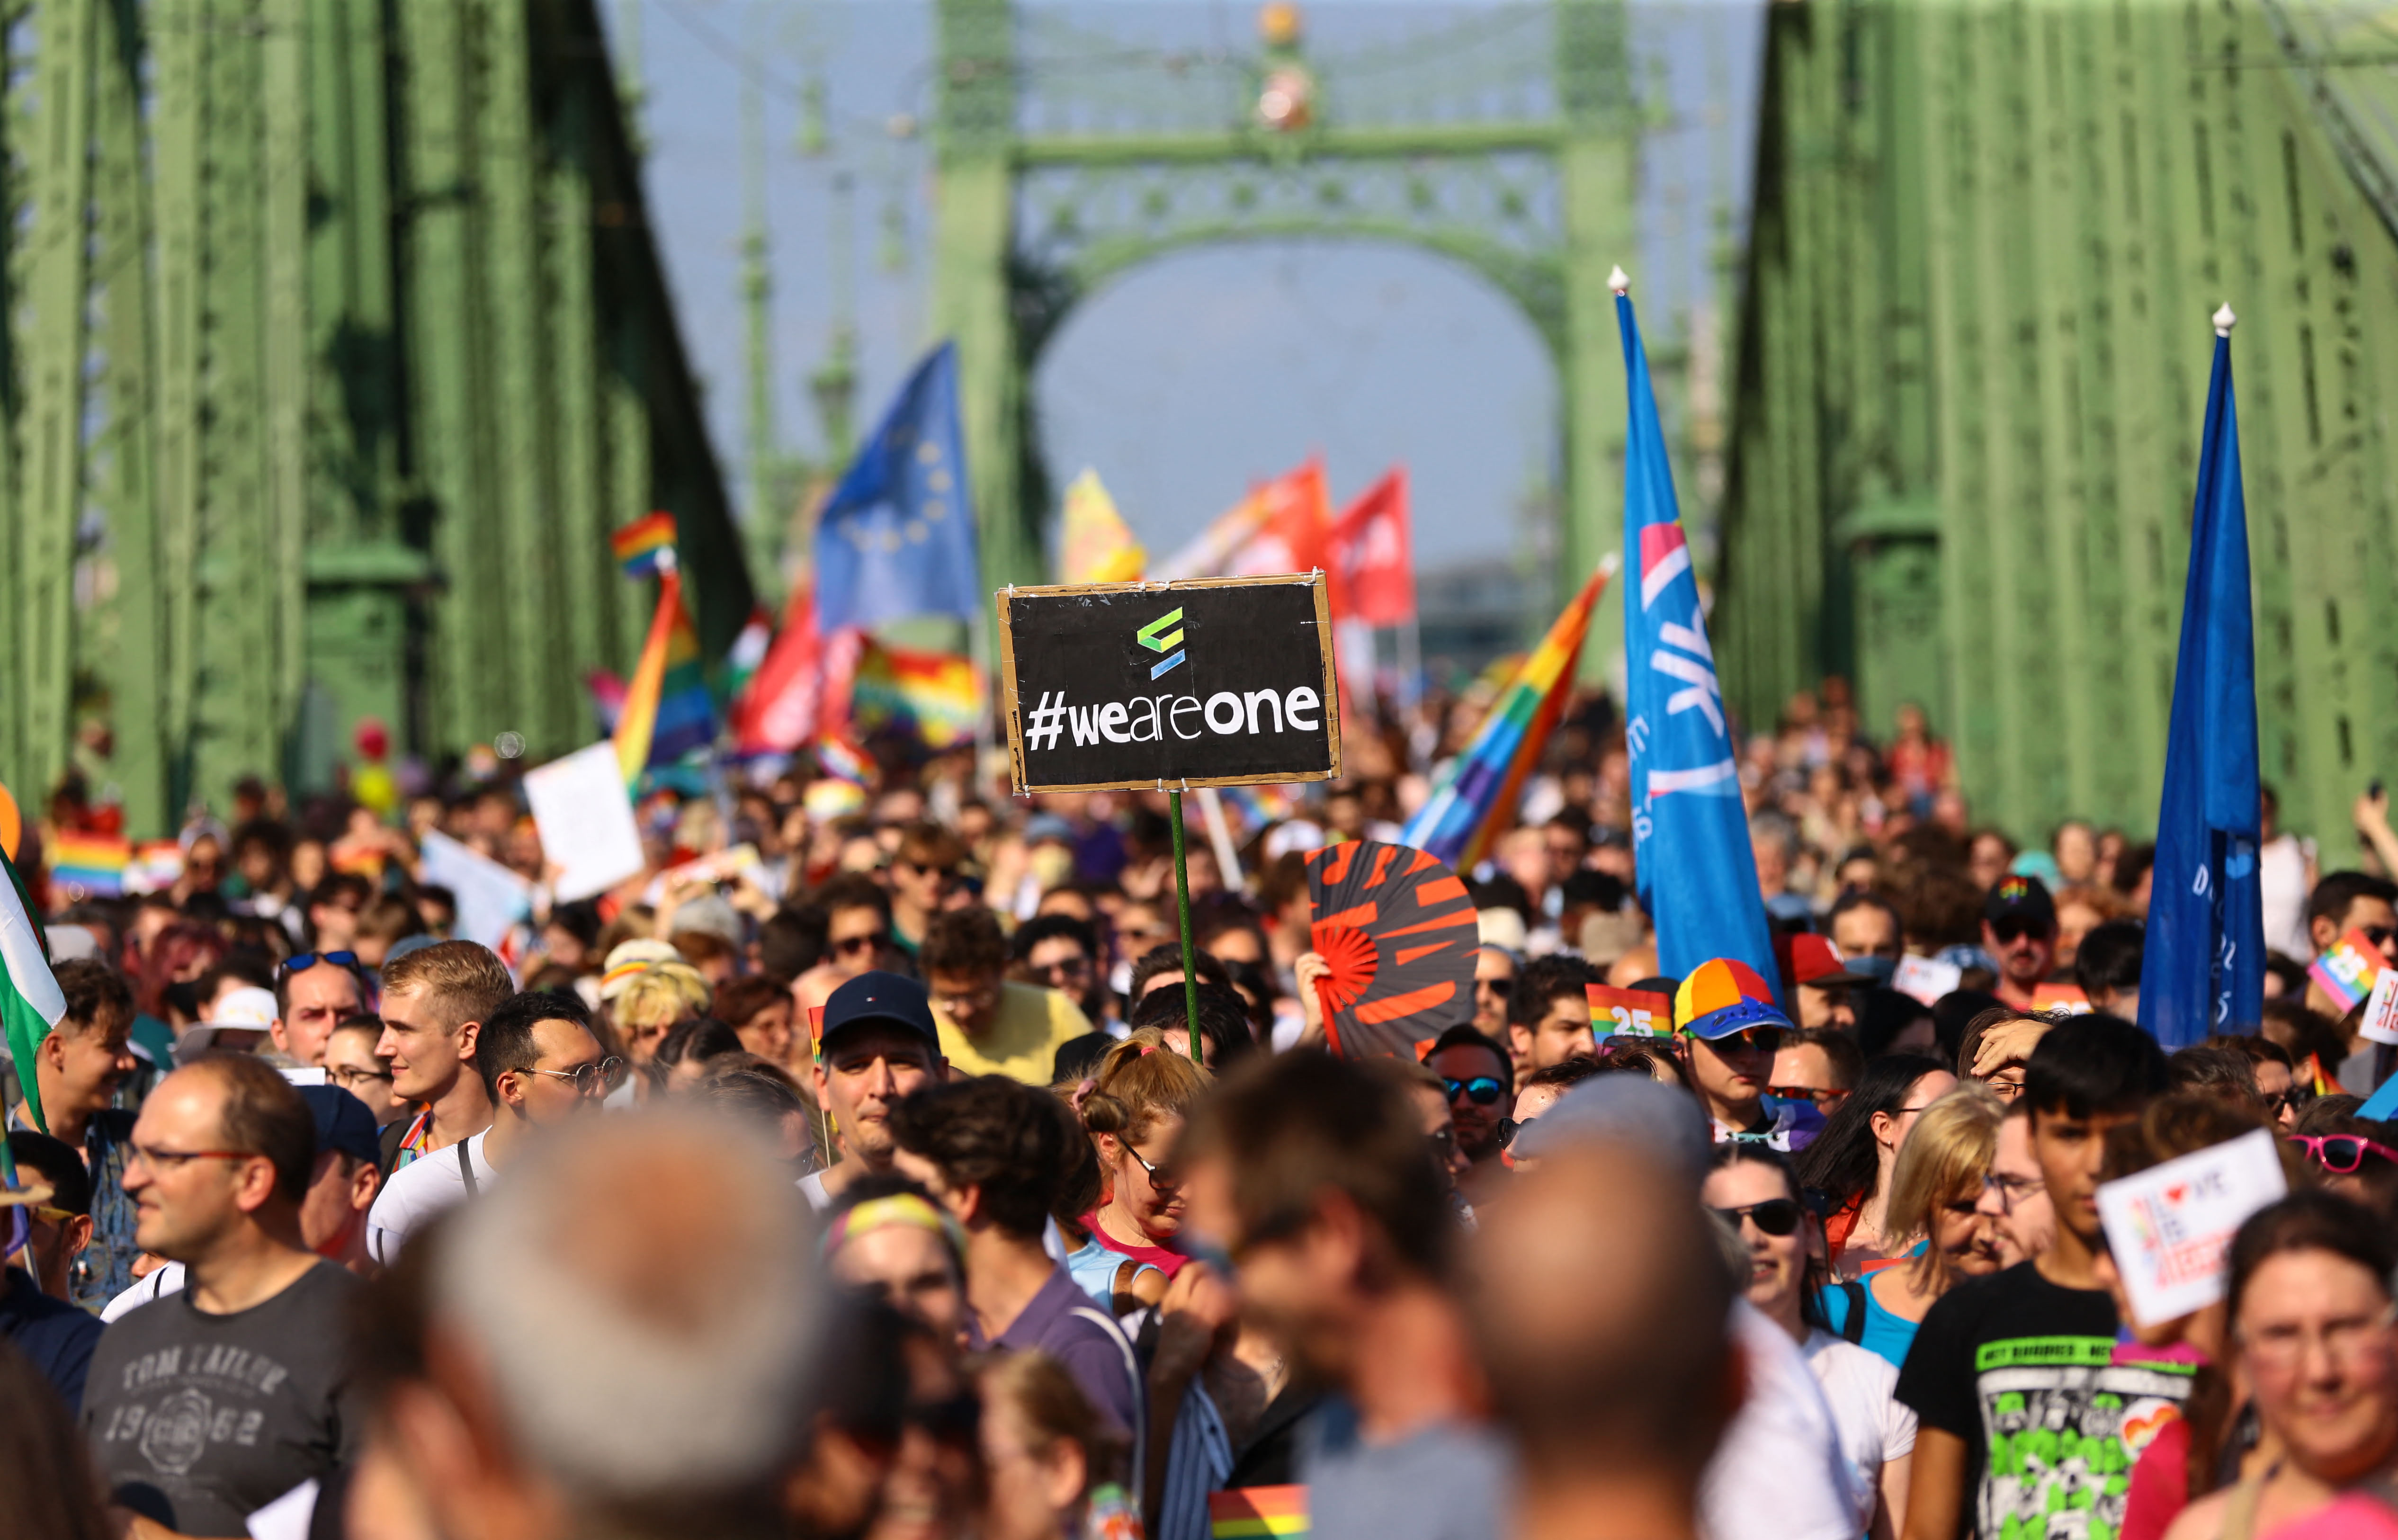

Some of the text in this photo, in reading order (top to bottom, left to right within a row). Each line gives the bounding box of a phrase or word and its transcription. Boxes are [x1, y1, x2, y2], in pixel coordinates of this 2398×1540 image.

[1026, 687, 1320, 751] #weareone
[1611, 1006, 1654, 1037] 25
[123, 1345, 182, 1389] TOM
[211, 1406, 264, 1446] 62
